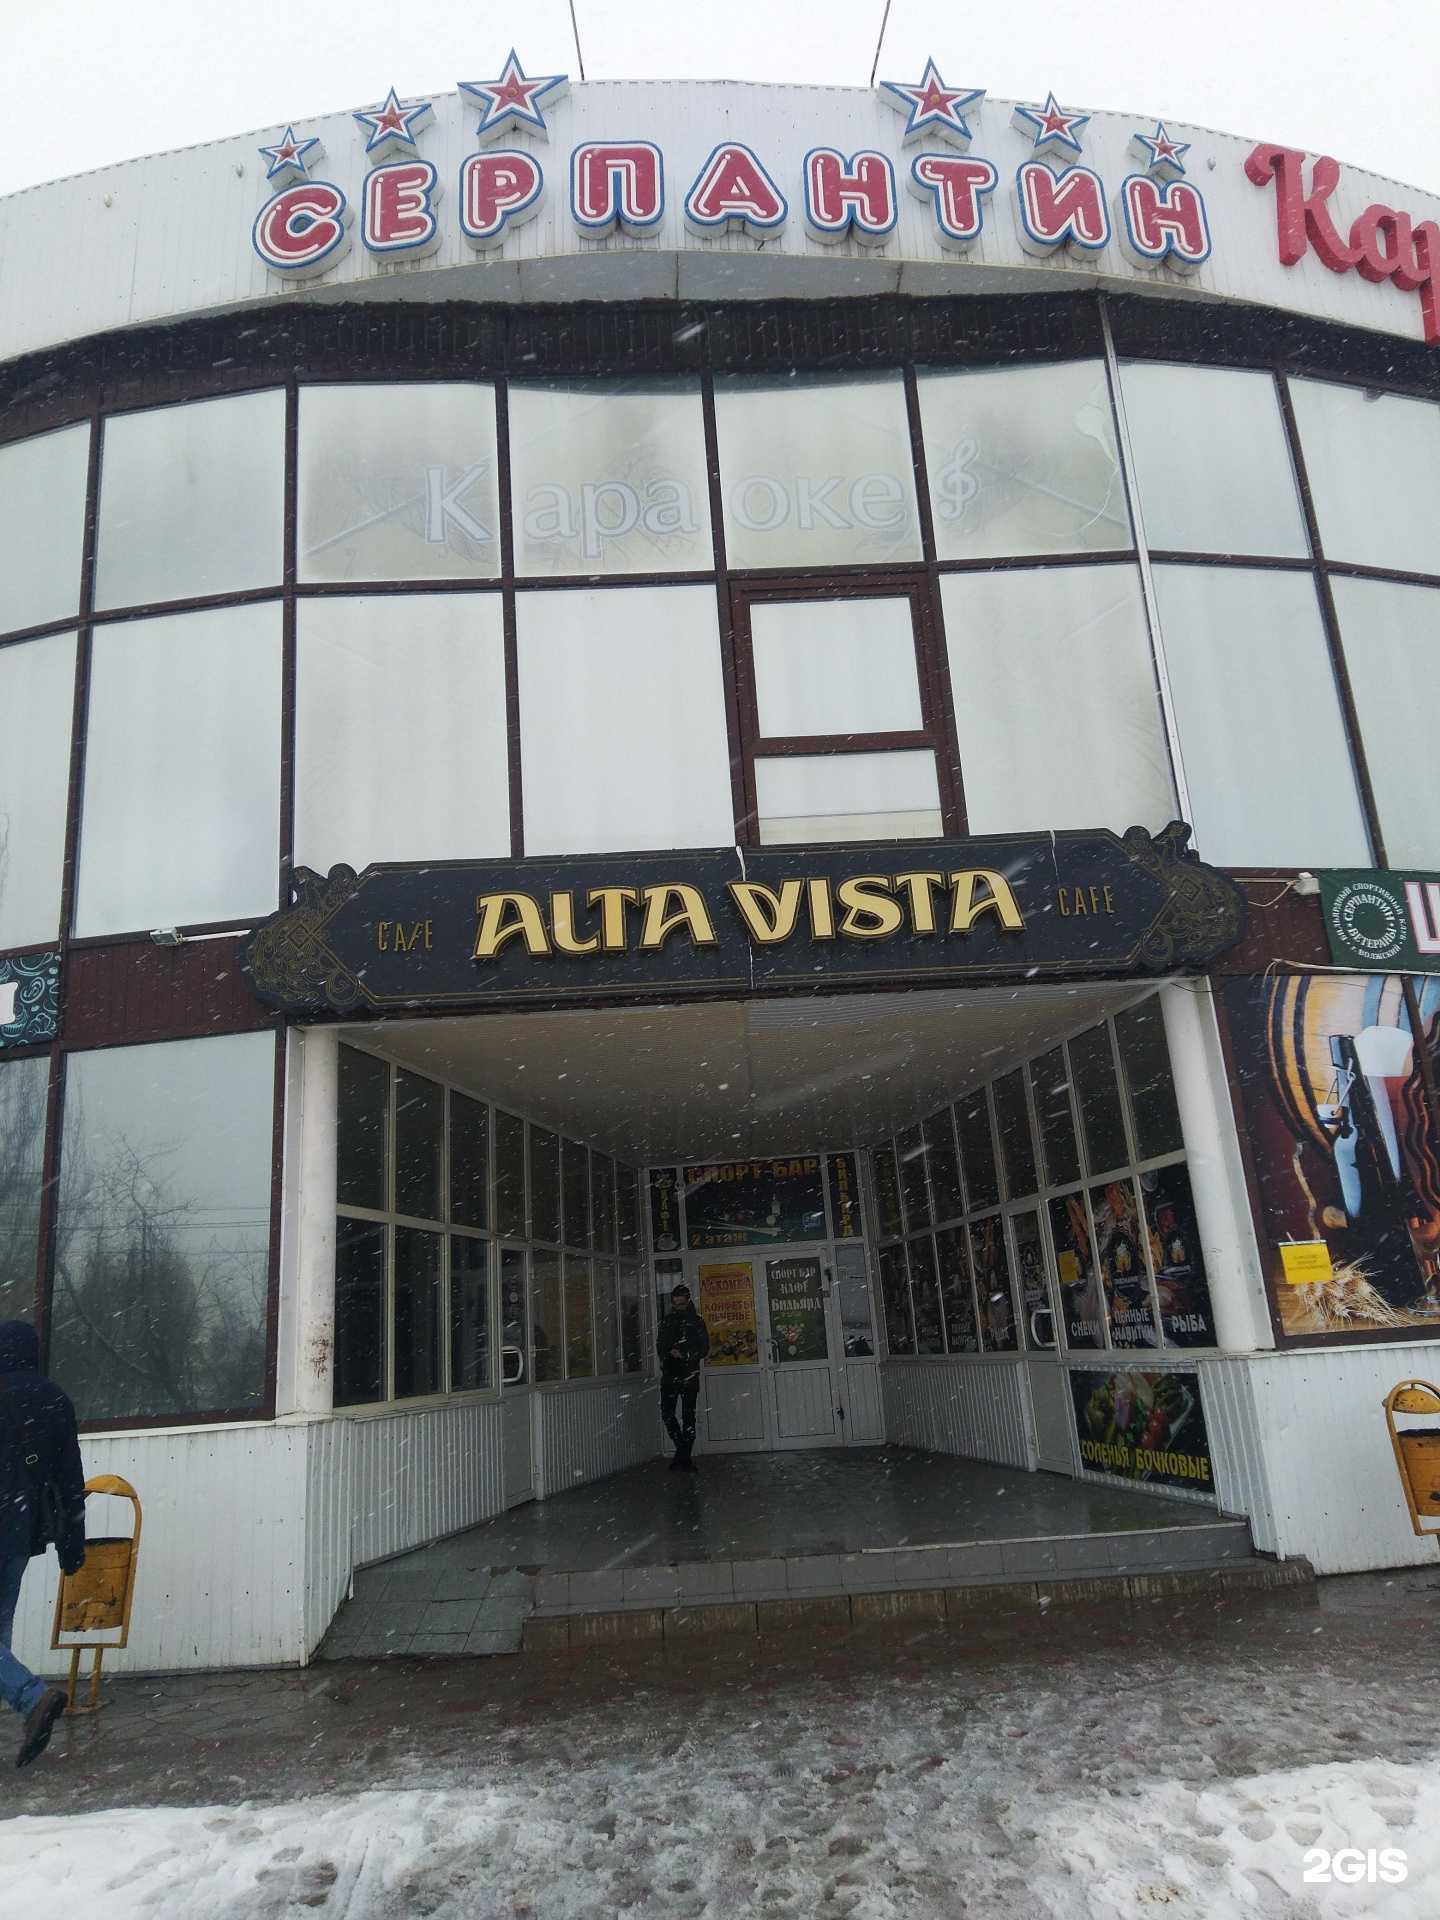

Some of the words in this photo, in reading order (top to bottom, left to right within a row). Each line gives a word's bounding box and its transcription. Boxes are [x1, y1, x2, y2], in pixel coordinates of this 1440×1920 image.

[252, 141, 1211, 278] СЕРПАНТИН
[473, 882, 720, 958] ALTA
[727, 867, 1026, 944] VISTA
[1058, 886, 1115, 915] CAFE
[1344, 894, 1396, 921] СЕРПАНТИН
[1347, 927, 1397, 949] ВЕТЕРАНЫ
[1172, 1314, 1208, 1334] РЫБА
[1081, 1440, 1130, 1467] СОЛЕНЬЯ
[1135, 1448, 1210, 1481] БОЧКОВЫЕ
